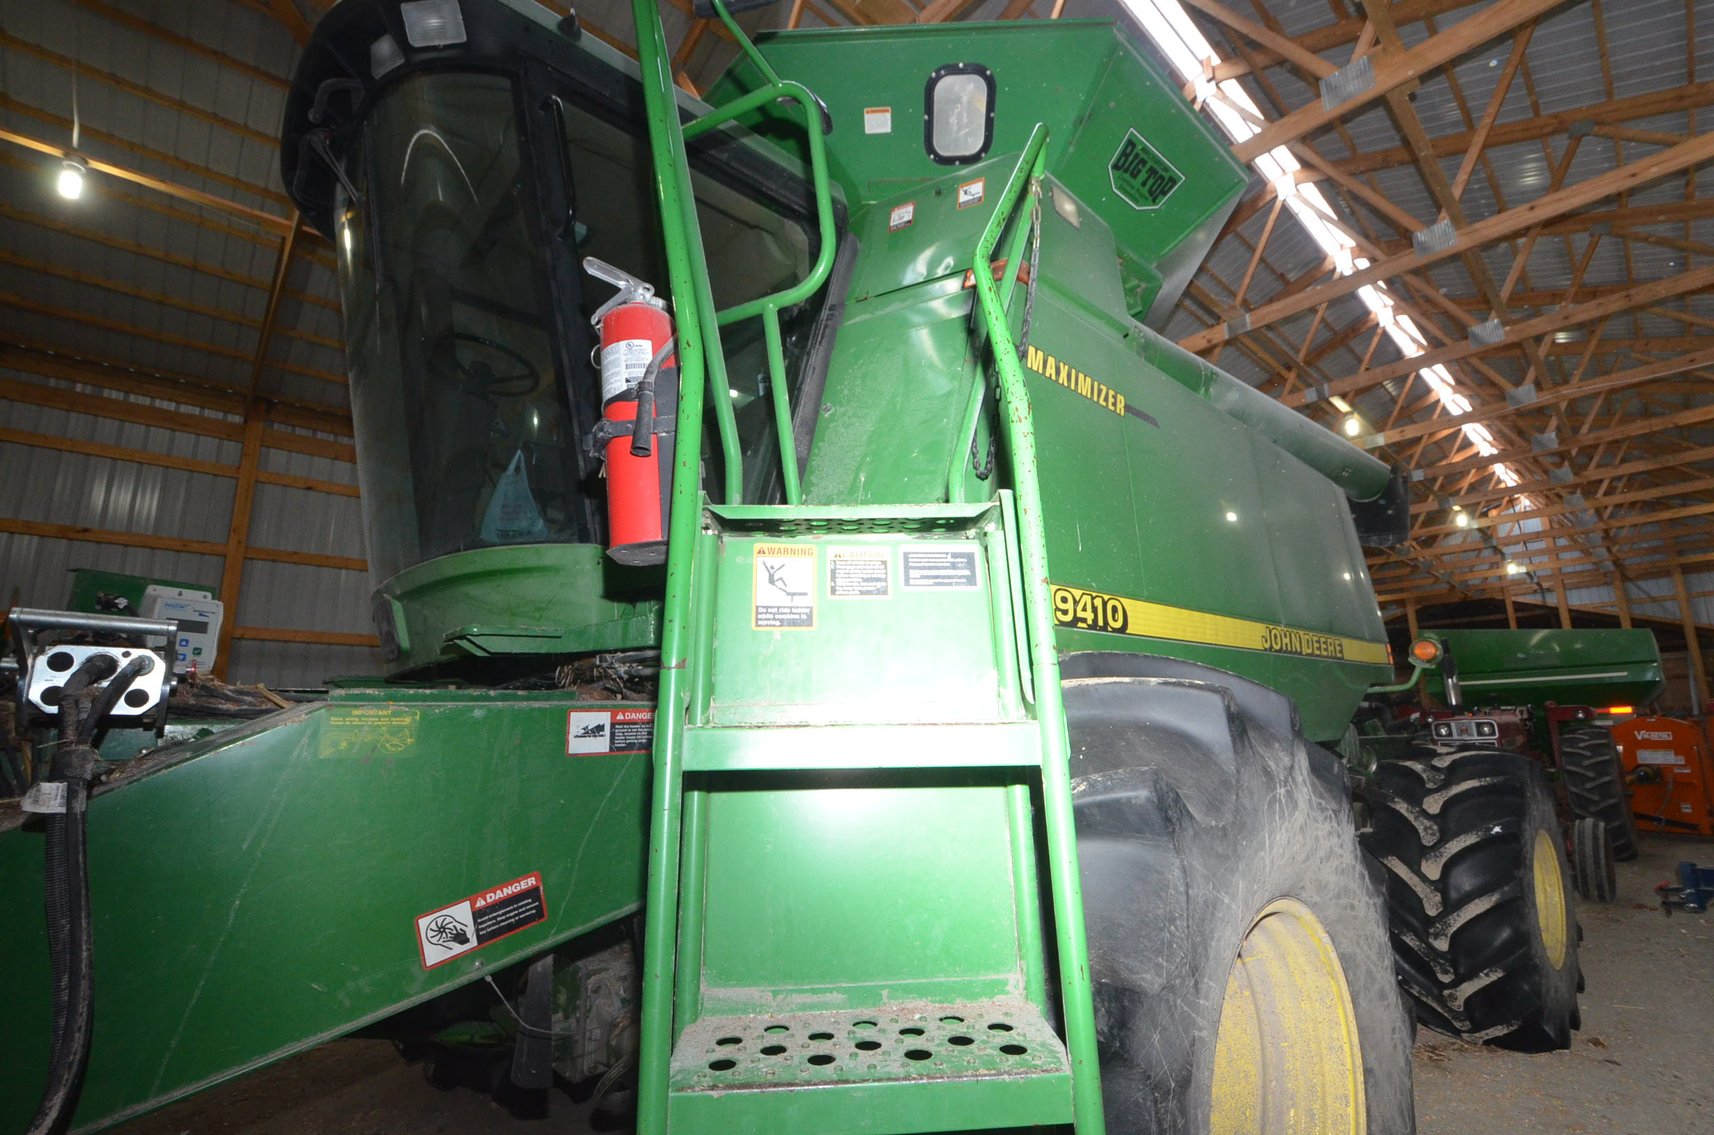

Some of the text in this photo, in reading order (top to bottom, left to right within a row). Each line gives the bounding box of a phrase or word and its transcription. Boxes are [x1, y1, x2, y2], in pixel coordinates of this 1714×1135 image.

[1112, 139, 1149, 179] BIG
[1141, 166, 1177, 203] TOP
[1026, 344, 1126, 417] MAXIMIZER
[767, 546, 814, 556] WARNING
[1053, 588, 1128, 633] 9410
[1262, 626, 1344, 660] JOHN DEERE
[486, 877, 536, 902] DANGER
